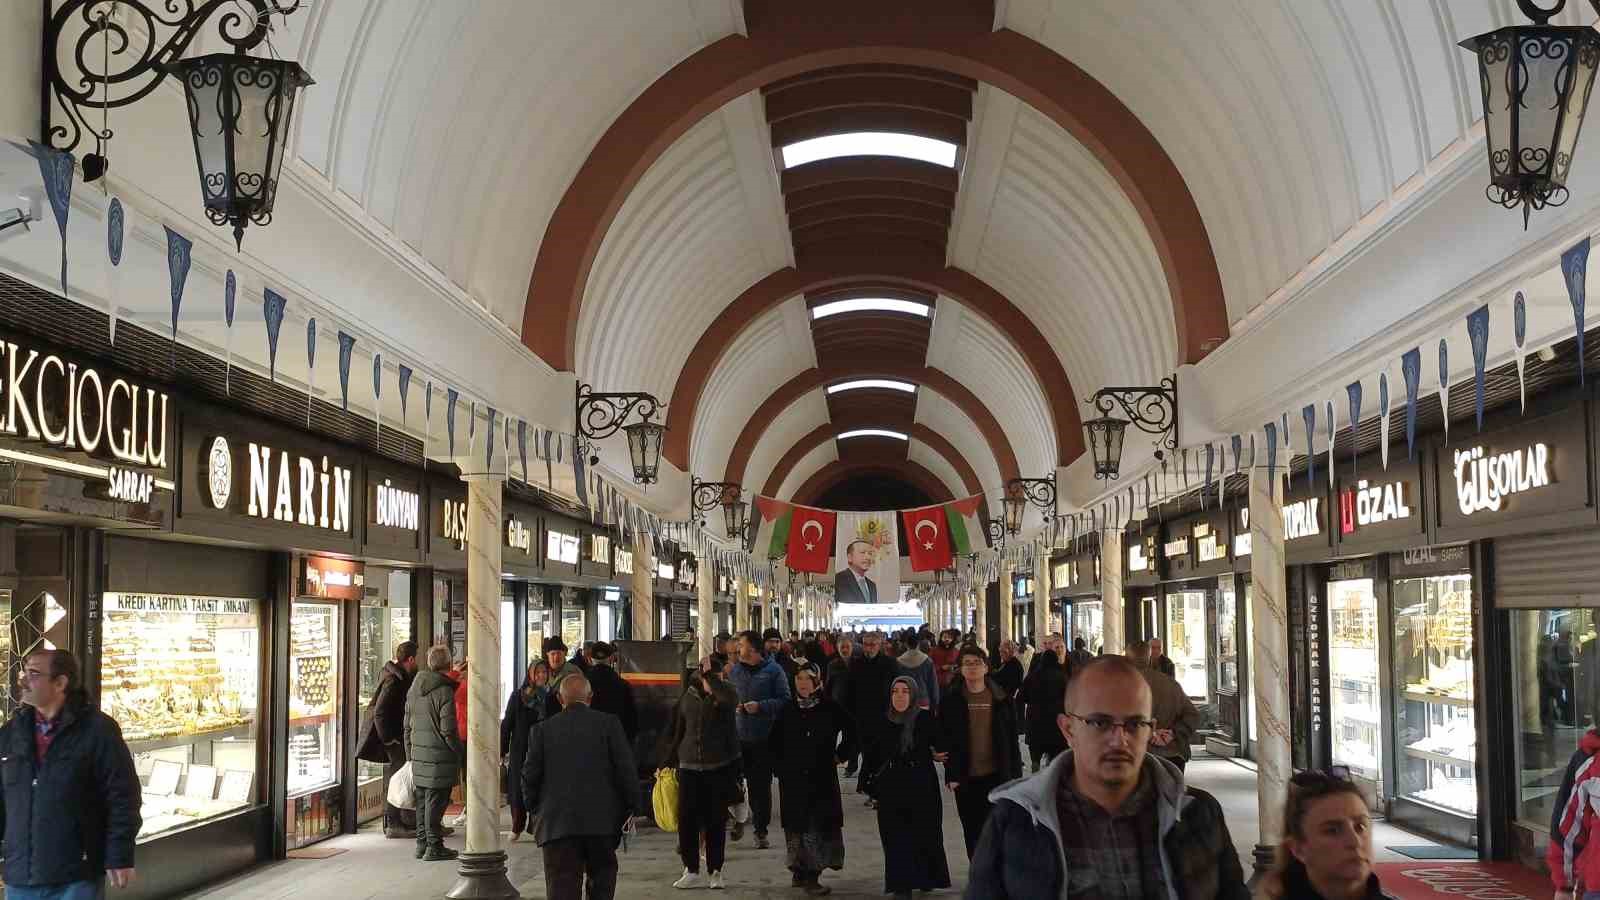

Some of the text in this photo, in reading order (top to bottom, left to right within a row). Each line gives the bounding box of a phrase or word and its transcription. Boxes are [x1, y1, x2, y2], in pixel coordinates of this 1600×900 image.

[108, 466, 153, 503] SARRAF
[376, 479, 419, 531] BÜNYAN
[1357, 480, 1409, 525] ÖZAL
[149, 595, 188, 612] KARTINA
